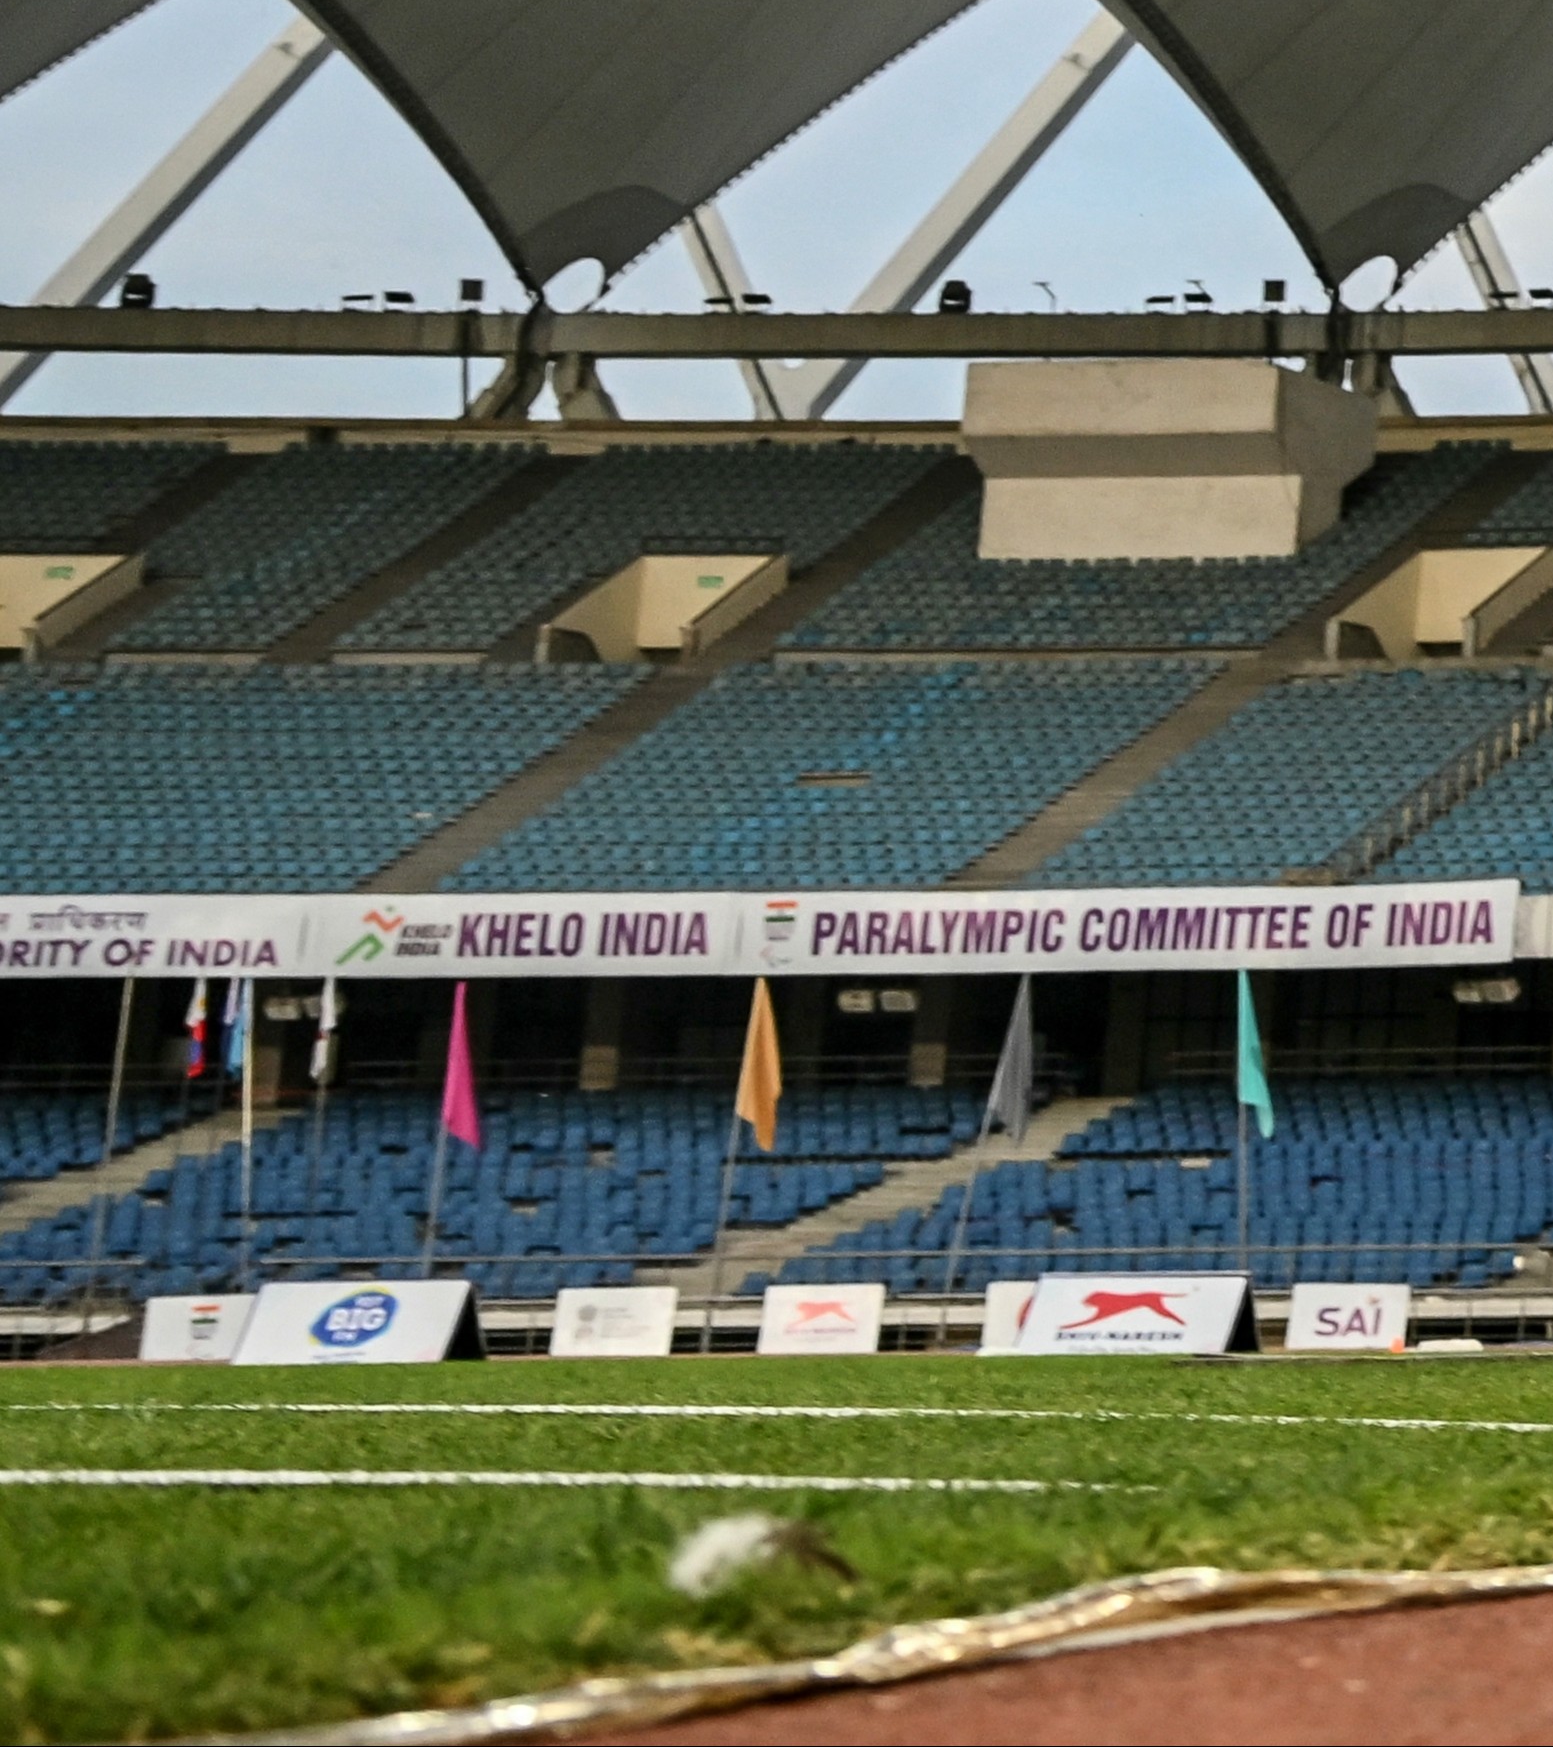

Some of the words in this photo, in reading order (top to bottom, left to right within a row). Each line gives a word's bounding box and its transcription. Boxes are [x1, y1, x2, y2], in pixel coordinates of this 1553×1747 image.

[455, 911, 585, 958] KHELO
[596, 911, 708, 956] INDIA
[811, 909, 1065, 955] PARALYMPIC
[1080, 905, 1312, 953] COMMITTEE
[1326, 903, 1374, 949] OF
[1386, 901, 1493, 946] INDIA
[0, 939, 92, 967] RITY
[104, 939, 155, 967] OF
[167, 939, 277, 967] INDIA
[324, 1307, 388, 1331] BIG
[1314, 1298, 1382, 1337] SAI
